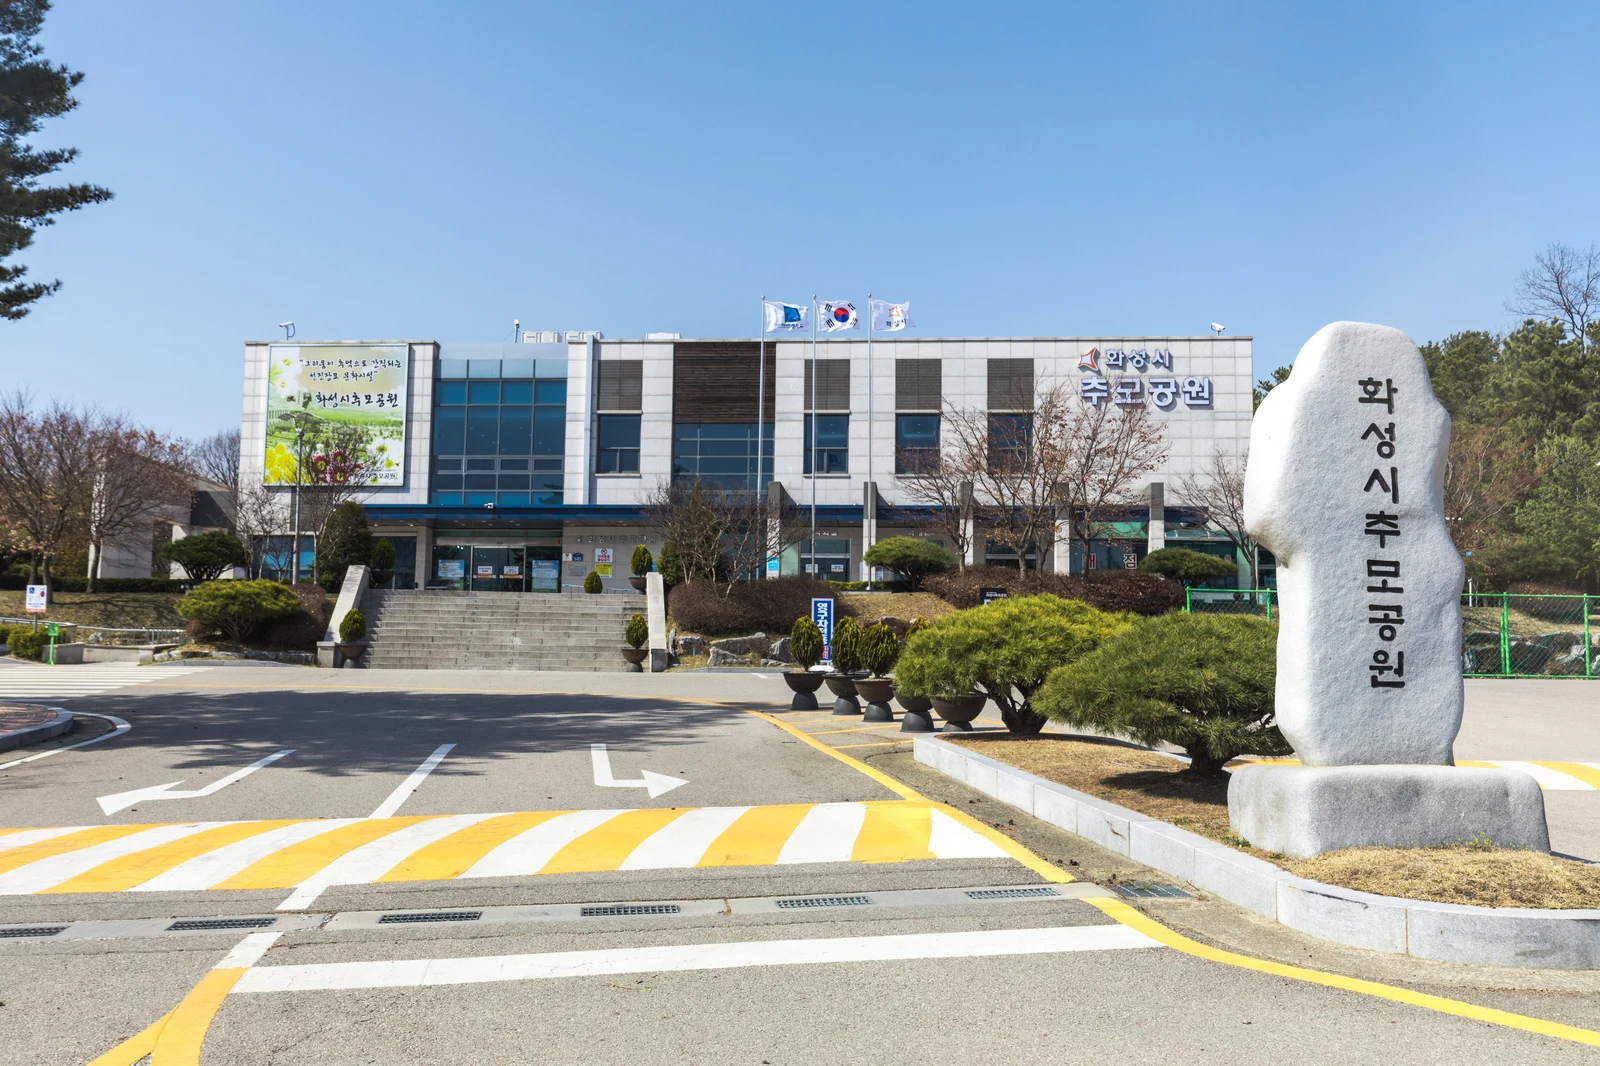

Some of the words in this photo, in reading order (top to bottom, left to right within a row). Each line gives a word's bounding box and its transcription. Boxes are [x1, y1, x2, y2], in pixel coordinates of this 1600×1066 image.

[337, 358, 368, 369] 추억으로
[371, 358, 402, 369] 간직되는
[1105, 349, 1170, 369] 화성시
[1080, 376, 1211, 408] 추모공원
[1358, 377, 1406, 689] 화성시추모공원
